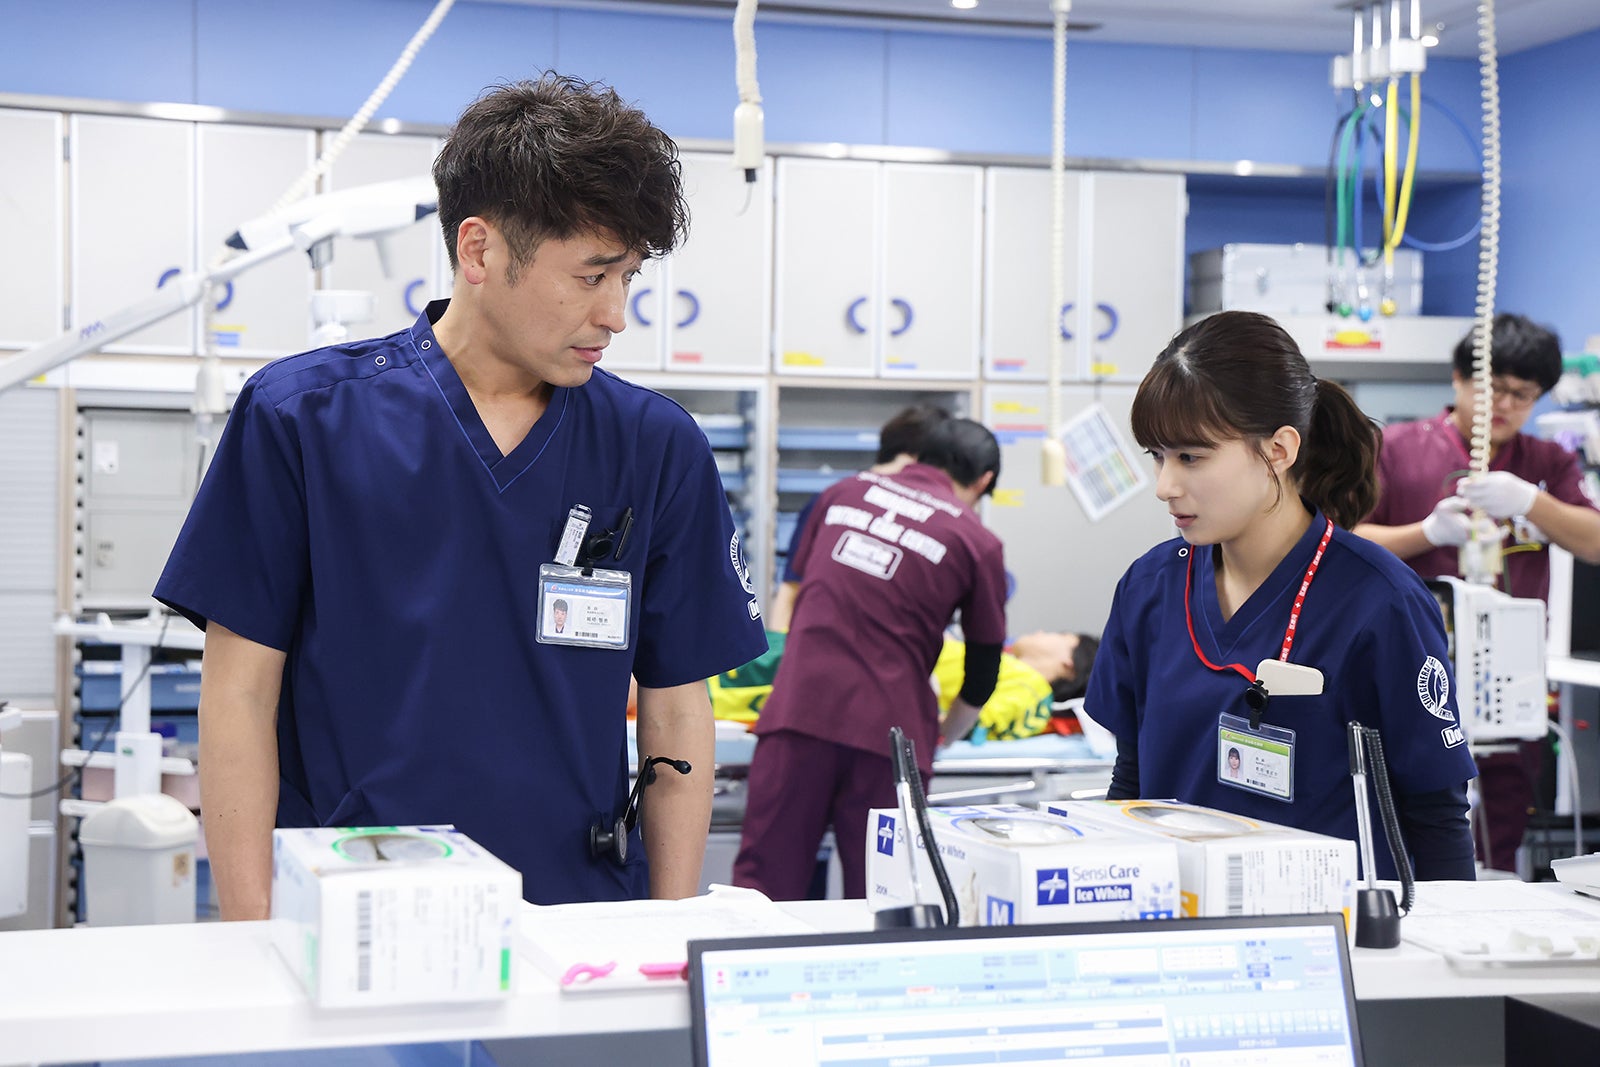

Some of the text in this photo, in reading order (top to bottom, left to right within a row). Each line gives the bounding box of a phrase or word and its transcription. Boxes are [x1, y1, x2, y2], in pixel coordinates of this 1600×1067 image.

[1076, 886, 1130, 902] Ice White
[991, 901, 1009, 925] M
